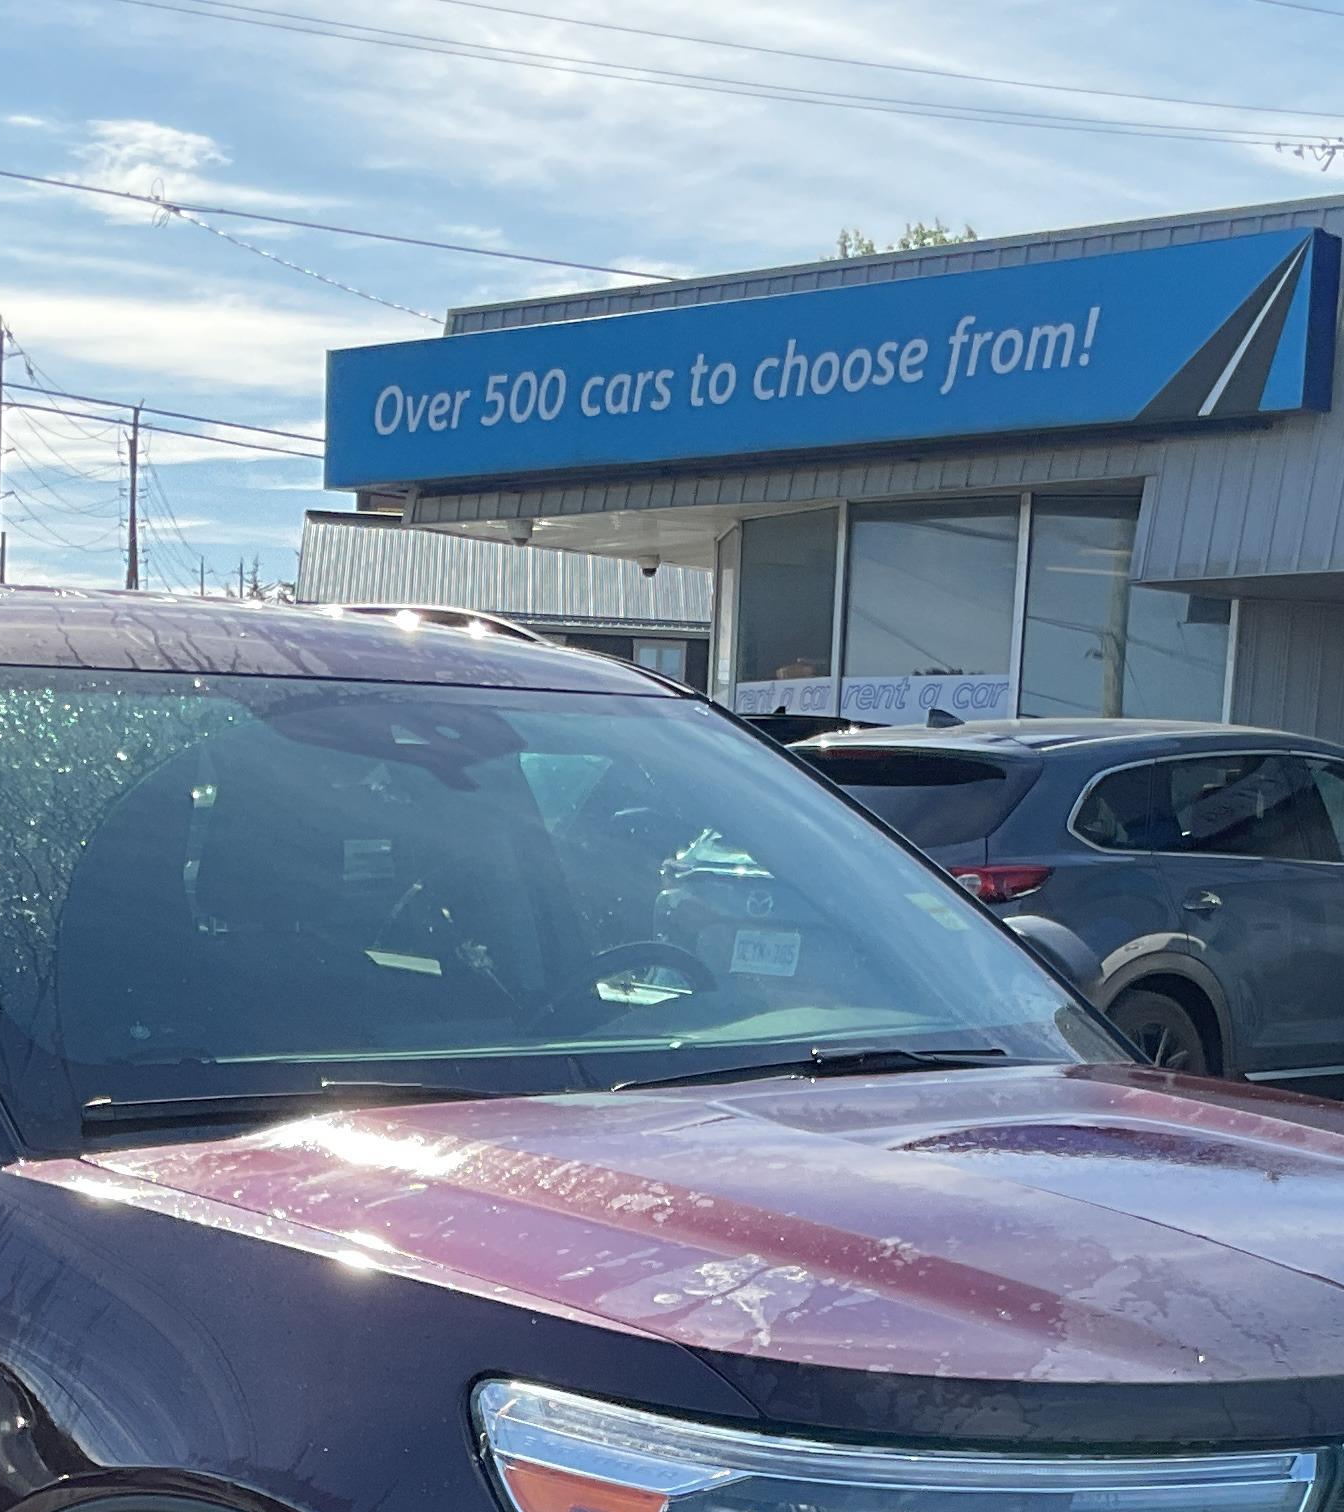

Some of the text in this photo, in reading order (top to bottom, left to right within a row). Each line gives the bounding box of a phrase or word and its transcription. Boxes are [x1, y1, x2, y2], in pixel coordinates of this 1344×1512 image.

[374, 306, 1101, 435] Over 500 cars to choose from!
[737, 682, 776, 711] rent
[843, 677, 1009, 711] rent a car
